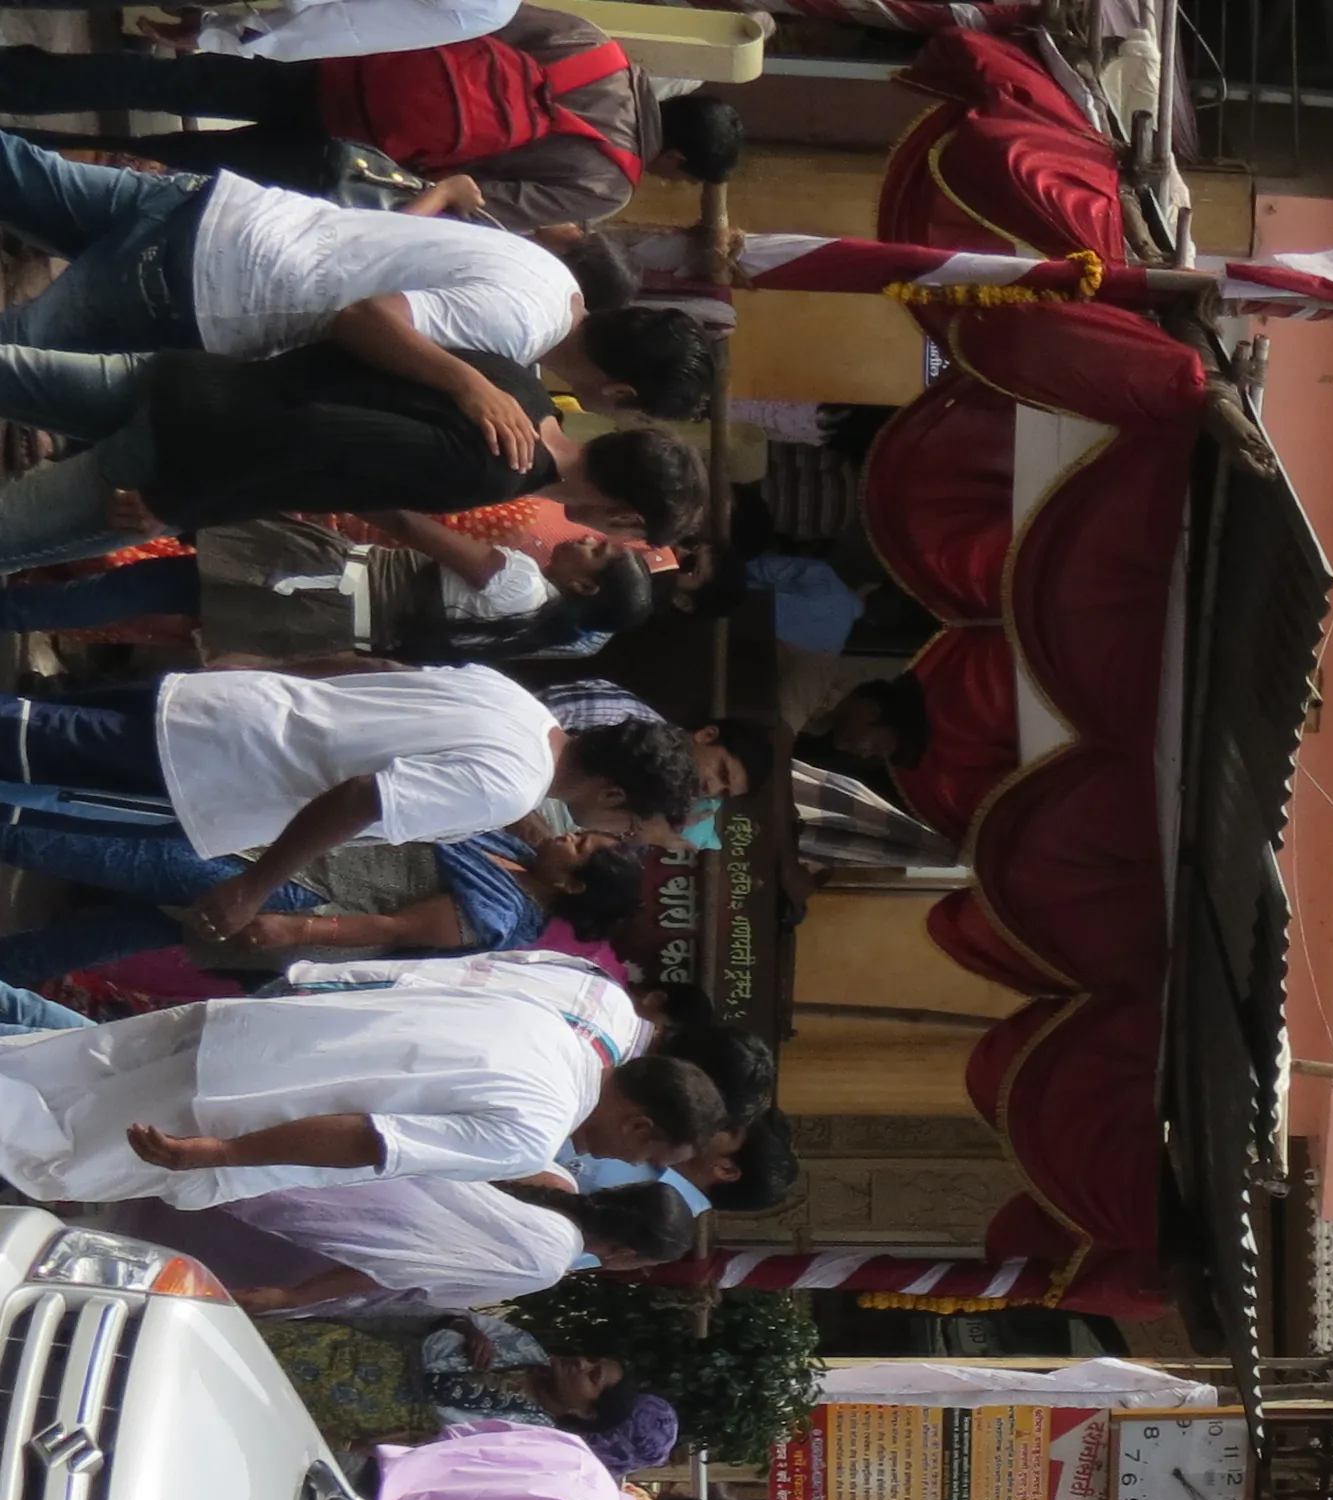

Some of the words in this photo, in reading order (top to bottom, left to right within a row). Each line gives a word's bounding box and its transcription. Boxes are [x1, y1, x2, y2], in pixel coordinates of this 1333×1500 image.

[729, 915, 757, 966] गणपती
[1144, 1427, 1159, 1439] 8
[1208, 1421, 1223, 1436] 10
[1124, 1449, 1140, 1462] 7
[1224, 1446, 1239, 1458] 11
[1122, 1473, 1137, 1486] 6
[1227, 1469, 1242, 1485] 12
